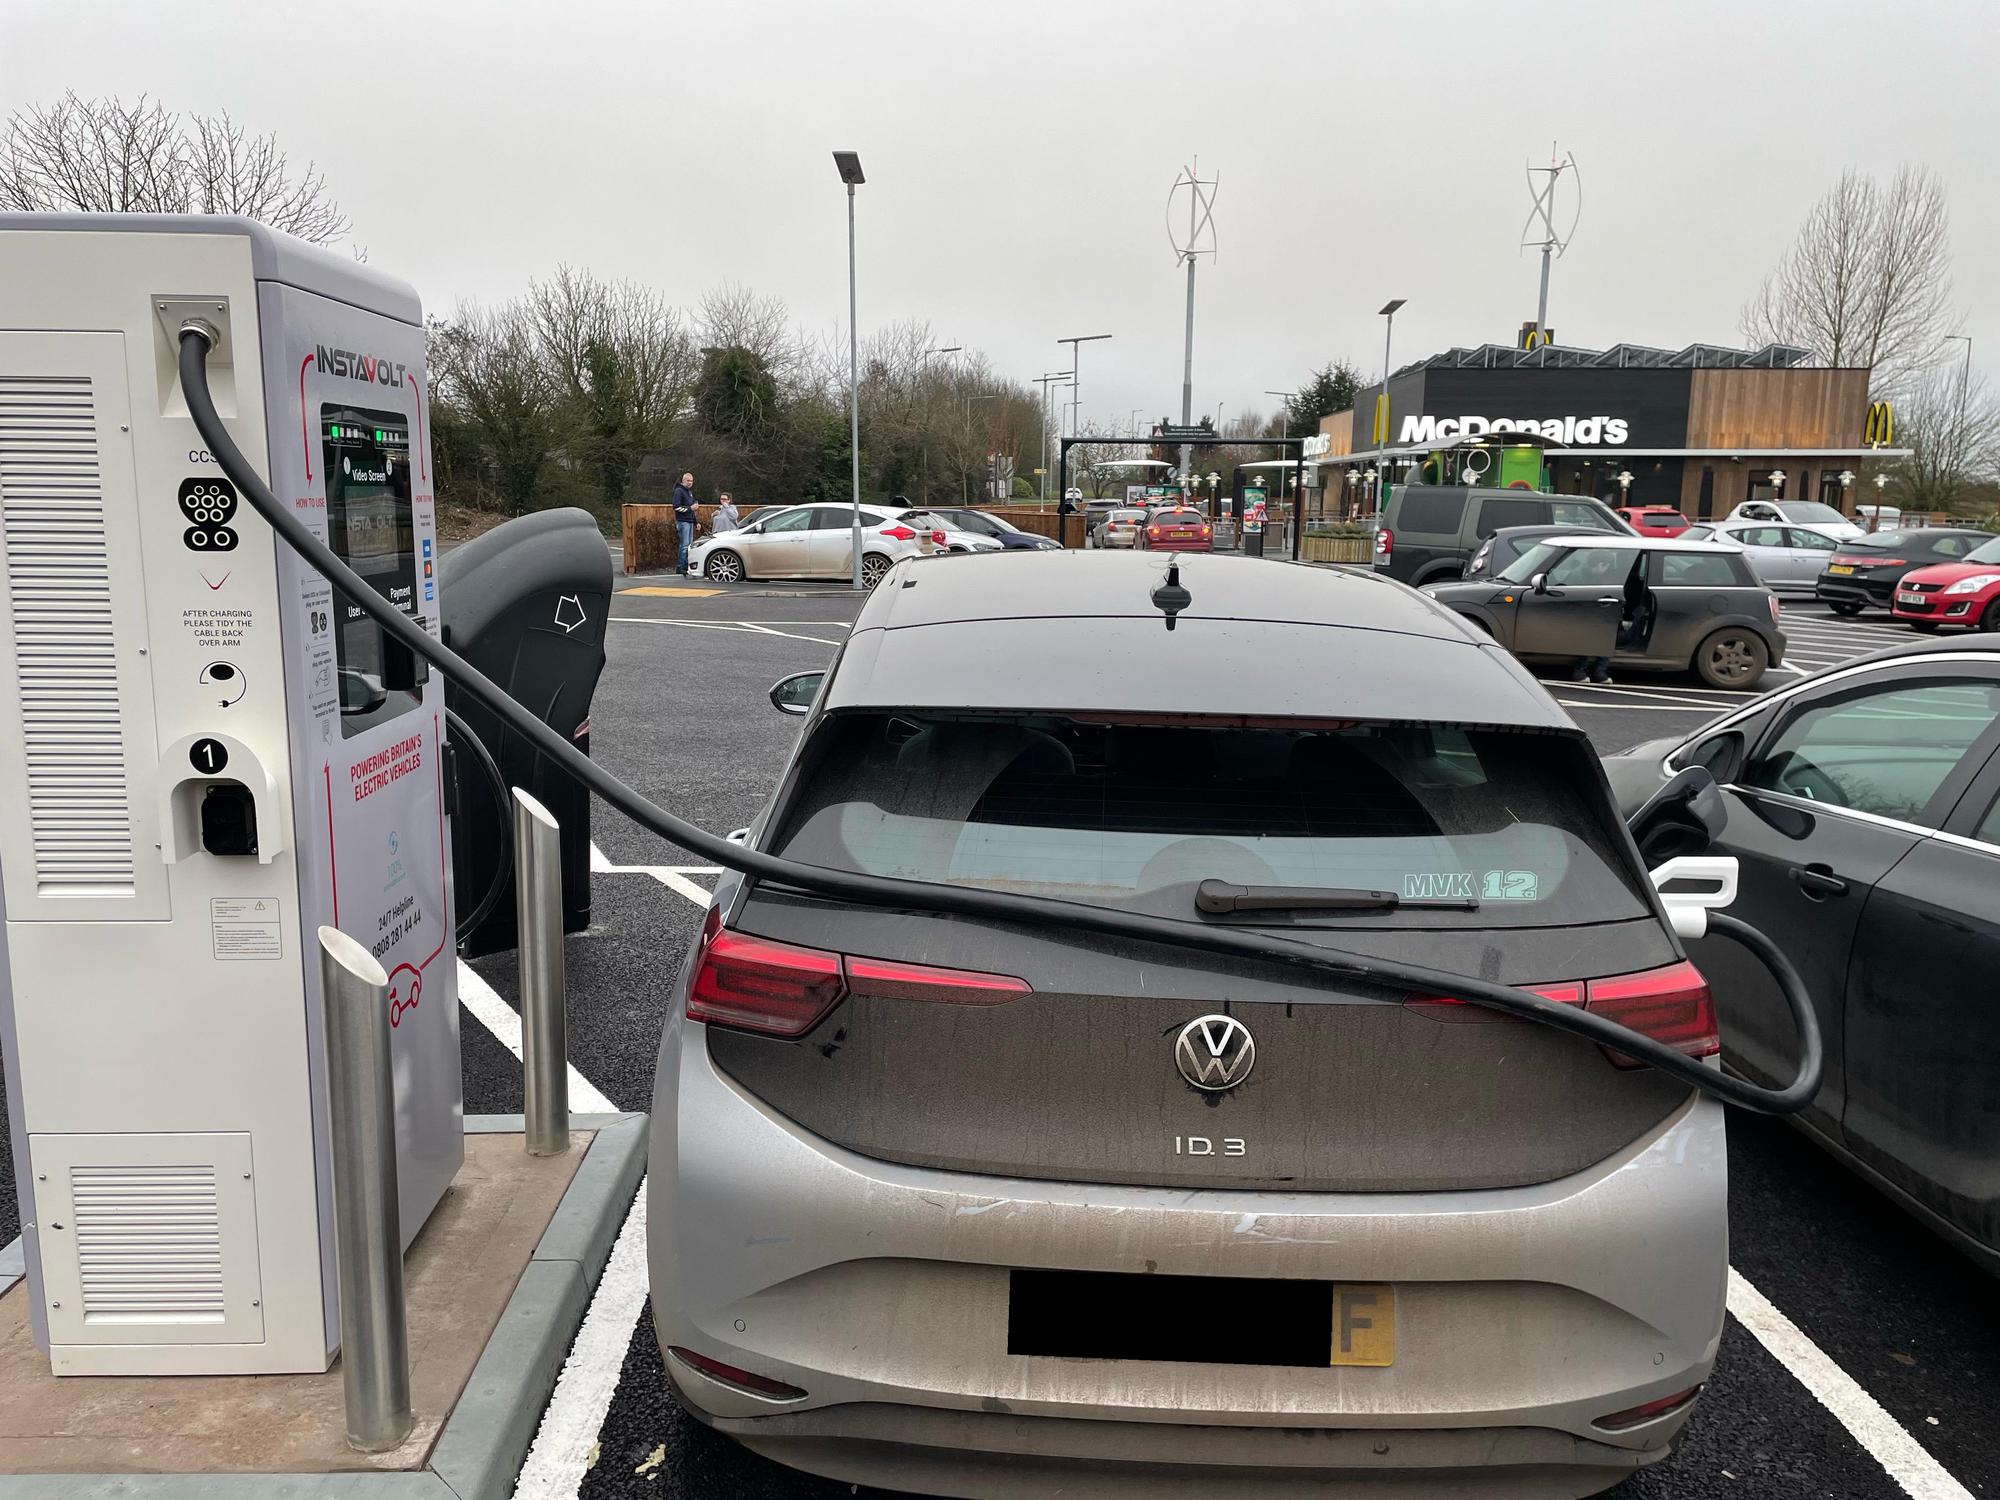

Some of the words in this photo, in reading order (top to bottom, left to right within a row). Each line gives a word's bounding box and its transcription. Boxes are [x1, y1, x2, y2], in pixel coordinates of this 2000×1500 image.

[317, 344, 406, 389] INSTAVOLT
[1399, 415, 1628, 445] McDonald's
[352, 469, 368, 482] Video
[368, 470, 386, 482] Screen
[296, 498, 308, 508] HOW
[308, 498, 315, 507] TO
[315, 497, 326, 508] USE
[390, 585, 410, 600] Payment
[348, 606, 361, 618] User
[202, 743, 214, 768] 1
[350, 749, 390, 782] POWERING
[390, 734, 422, 763] BRITAIN'S
[354, 770, 389, 802] ELECTRIC
[389, 753, 421, 782] VEHICLES
[1404, 873, 1473, 898] MVK
[1481, 869, 1538, 900] 12
[379, 910, 391, 931] 24/7
[392, 895, 413, 920] Helpline
[372, 935, 390, 959] 0808
[390, 924, 403, 946] 281
[404, 916, 413, 934] 44
[413, 908, 421, 925] 44
